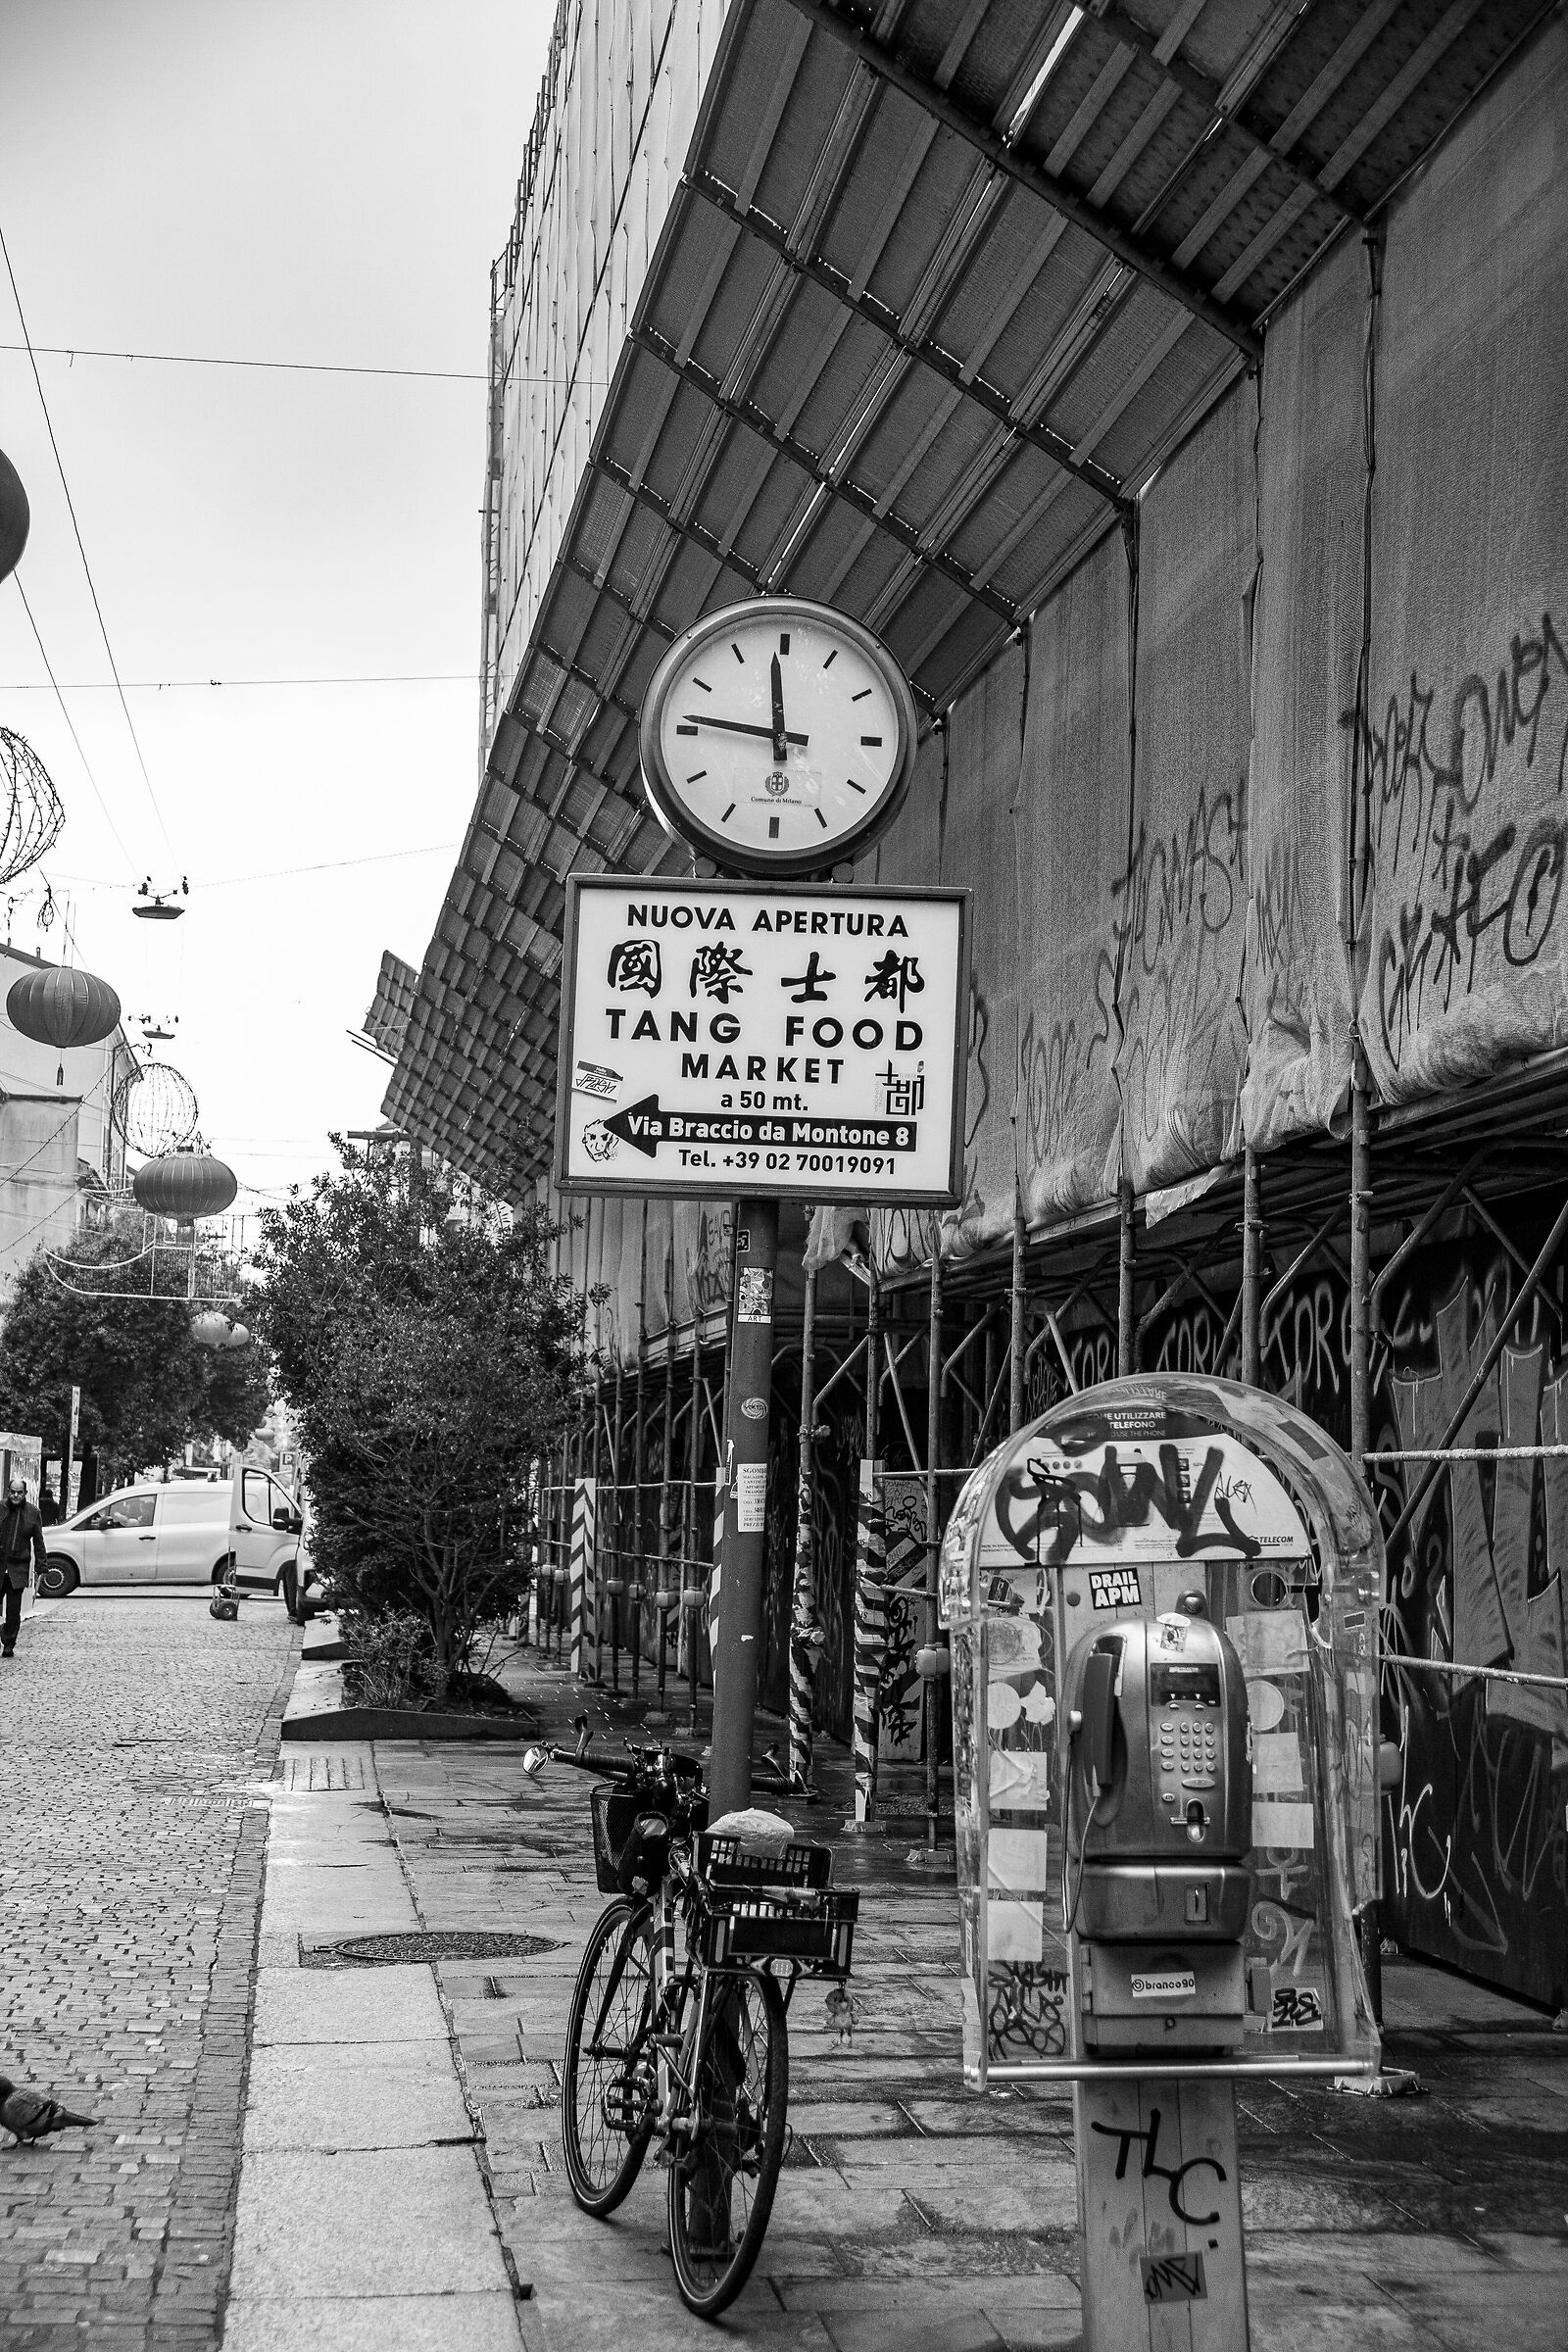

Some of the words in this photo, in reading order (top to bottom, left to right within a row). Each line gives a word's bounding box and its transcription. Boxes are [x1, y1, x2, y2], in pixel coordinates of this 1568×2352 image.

[627, 904, 736, 932] NUOVA
[752, 908, 909, 938] APERTURA
[606, 1007, 741, 1043] TANG
[785, 1015, 924, 1052] FOOD
[681, 1053, 845, 1085] MARKET
[720, 1095, 733, 1108] a
[740, 1091, 765, 1110] 50
[773, 1092, 808, 1112] mt.
[627, 1112, 662, 1137] Via
[668, 1116, 754, 1141] Braccio
[759, 1120, 786, 1142] da
[792, 1122, 890, 1147] Montone
[896, 1126, 909, 1146] 8
[678, 1149, 716, 1169] Tel.
[722, 1152, 759, 1170] +39
[765, 1153, 790, 1171] 02
[796, 1154, 896, 1175] 70019091
[1109, 1420, 1156, 1429] TELEFONO
[1114, 1411, 1167, 1420] UTILIZZARE
[1091, 1570, 1138, 1590] DRAIL
[1095, 1585, 1140, 1607] APM
[1145, 1978, 1195, 1990] branco90
